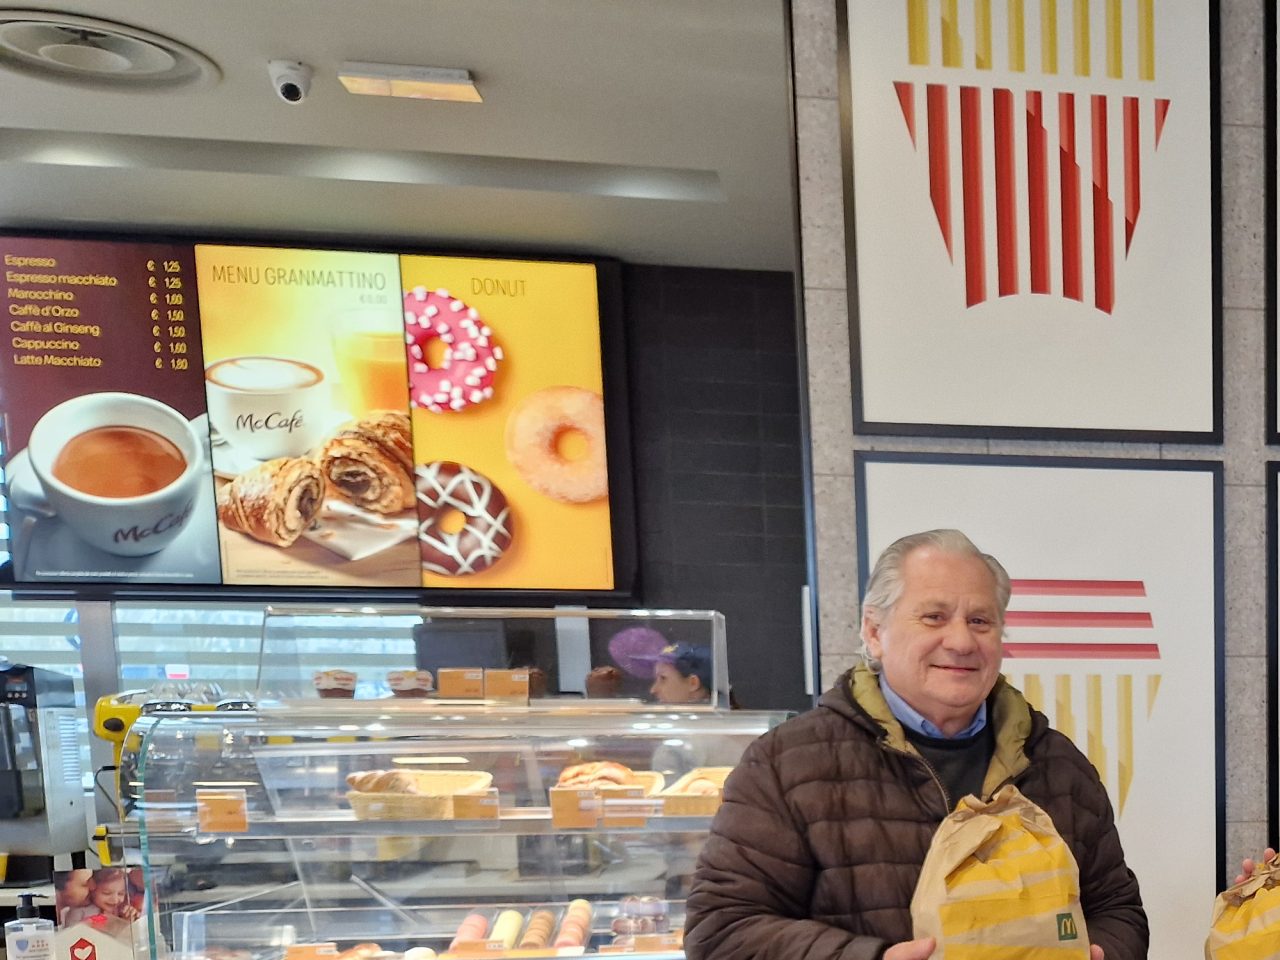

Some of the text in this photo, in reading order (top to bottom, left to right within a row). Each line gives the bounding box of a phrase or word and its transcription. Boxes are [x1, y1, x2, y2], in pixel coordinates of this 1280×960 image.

[5, 254, 56, 268] Espresso
[6, 271, 57, 284] Espresso
[58, 274, 118, 287] macchiato
[212, 265, 386, 291] MENU GRANMATTINO
[8, 288, 74, 300] Marocchino
[471, 277, 527, 297] DONUT
[54, 322, 100, 337] Ginseng
[12, 337, 80, 350] Cappuccino
[14, 354, 43, 366] Latte
[44, 355, 102, 367] Macchiato
[236, 409, 303, 433] McCafé
